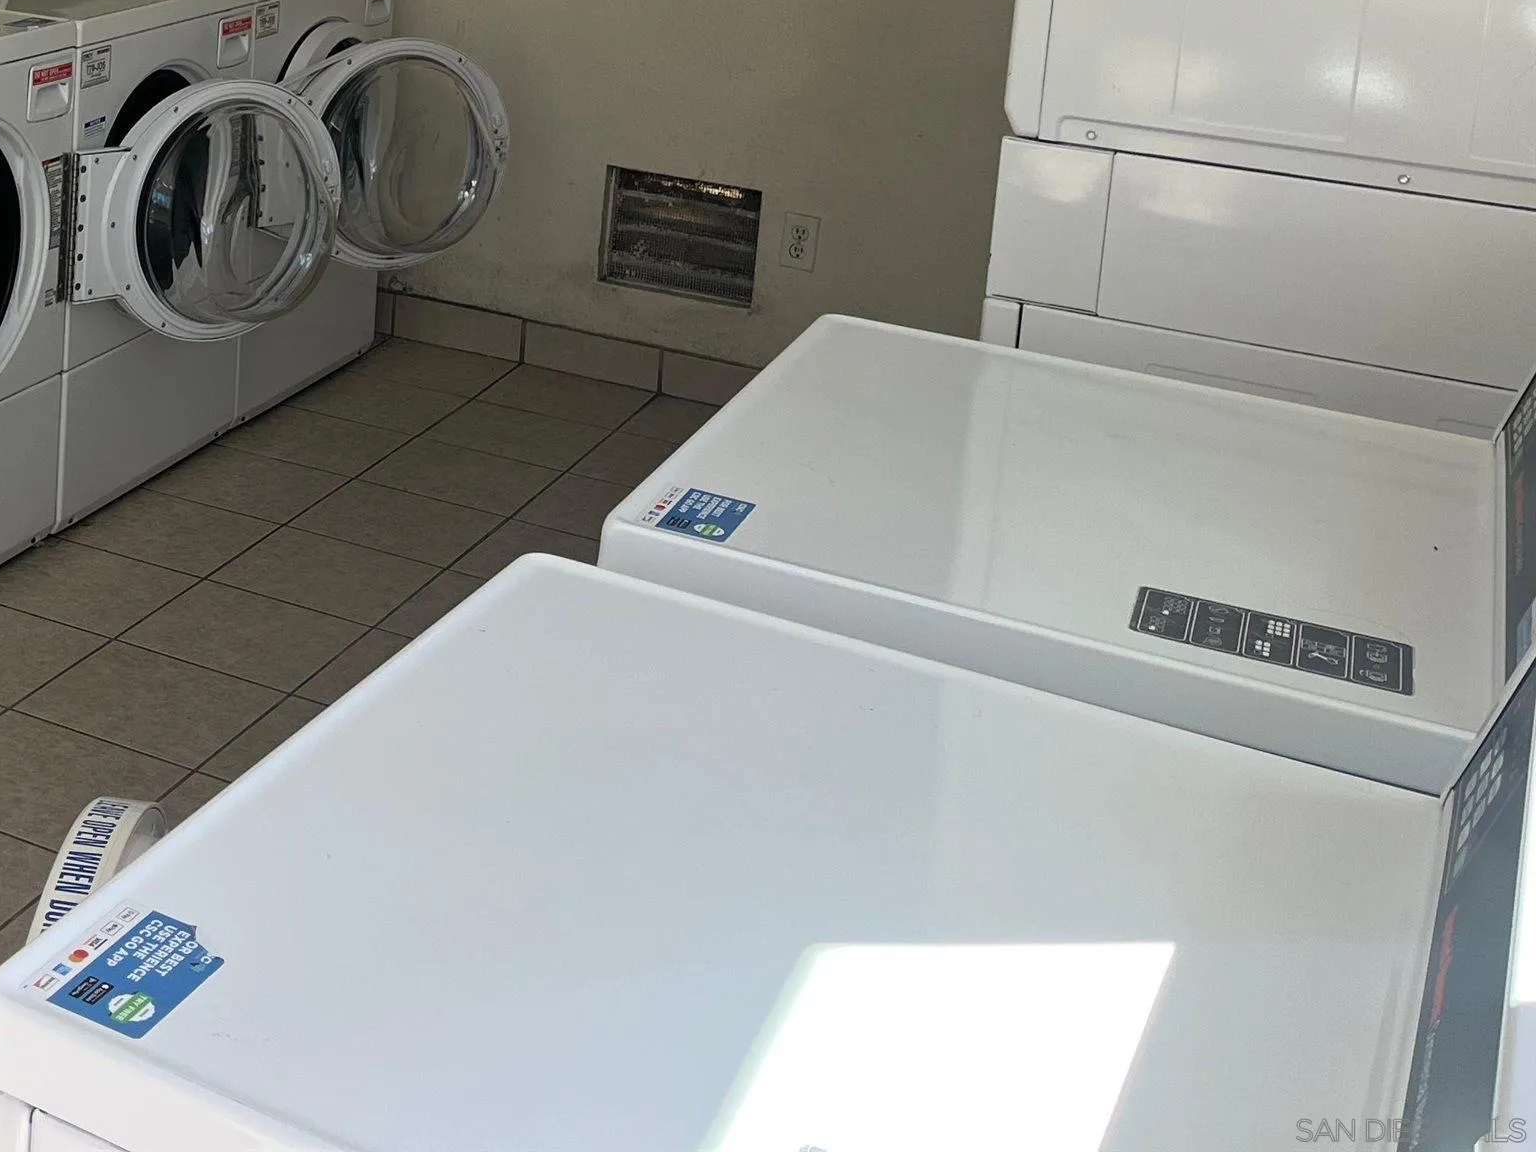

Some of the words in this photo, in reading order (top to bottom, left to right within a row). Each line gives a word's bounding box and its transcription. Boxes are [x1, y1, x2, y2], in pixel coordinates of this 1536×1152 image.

[72, 820, 117, 848] OPEN
[54, 851, 103, 895] WHEN
[40, 899, 79, 934] DO
[139, 919, 163, 937] CSC
[152, 925, 178, 943] USE
[124, 935, 144, 949] GO
[133, 942, 159, 960] THE
[107, 947, 129, 967] APP
[126, 930, 191, 982] EXPERIENCE
[155, 953, 185, 977] BEST
